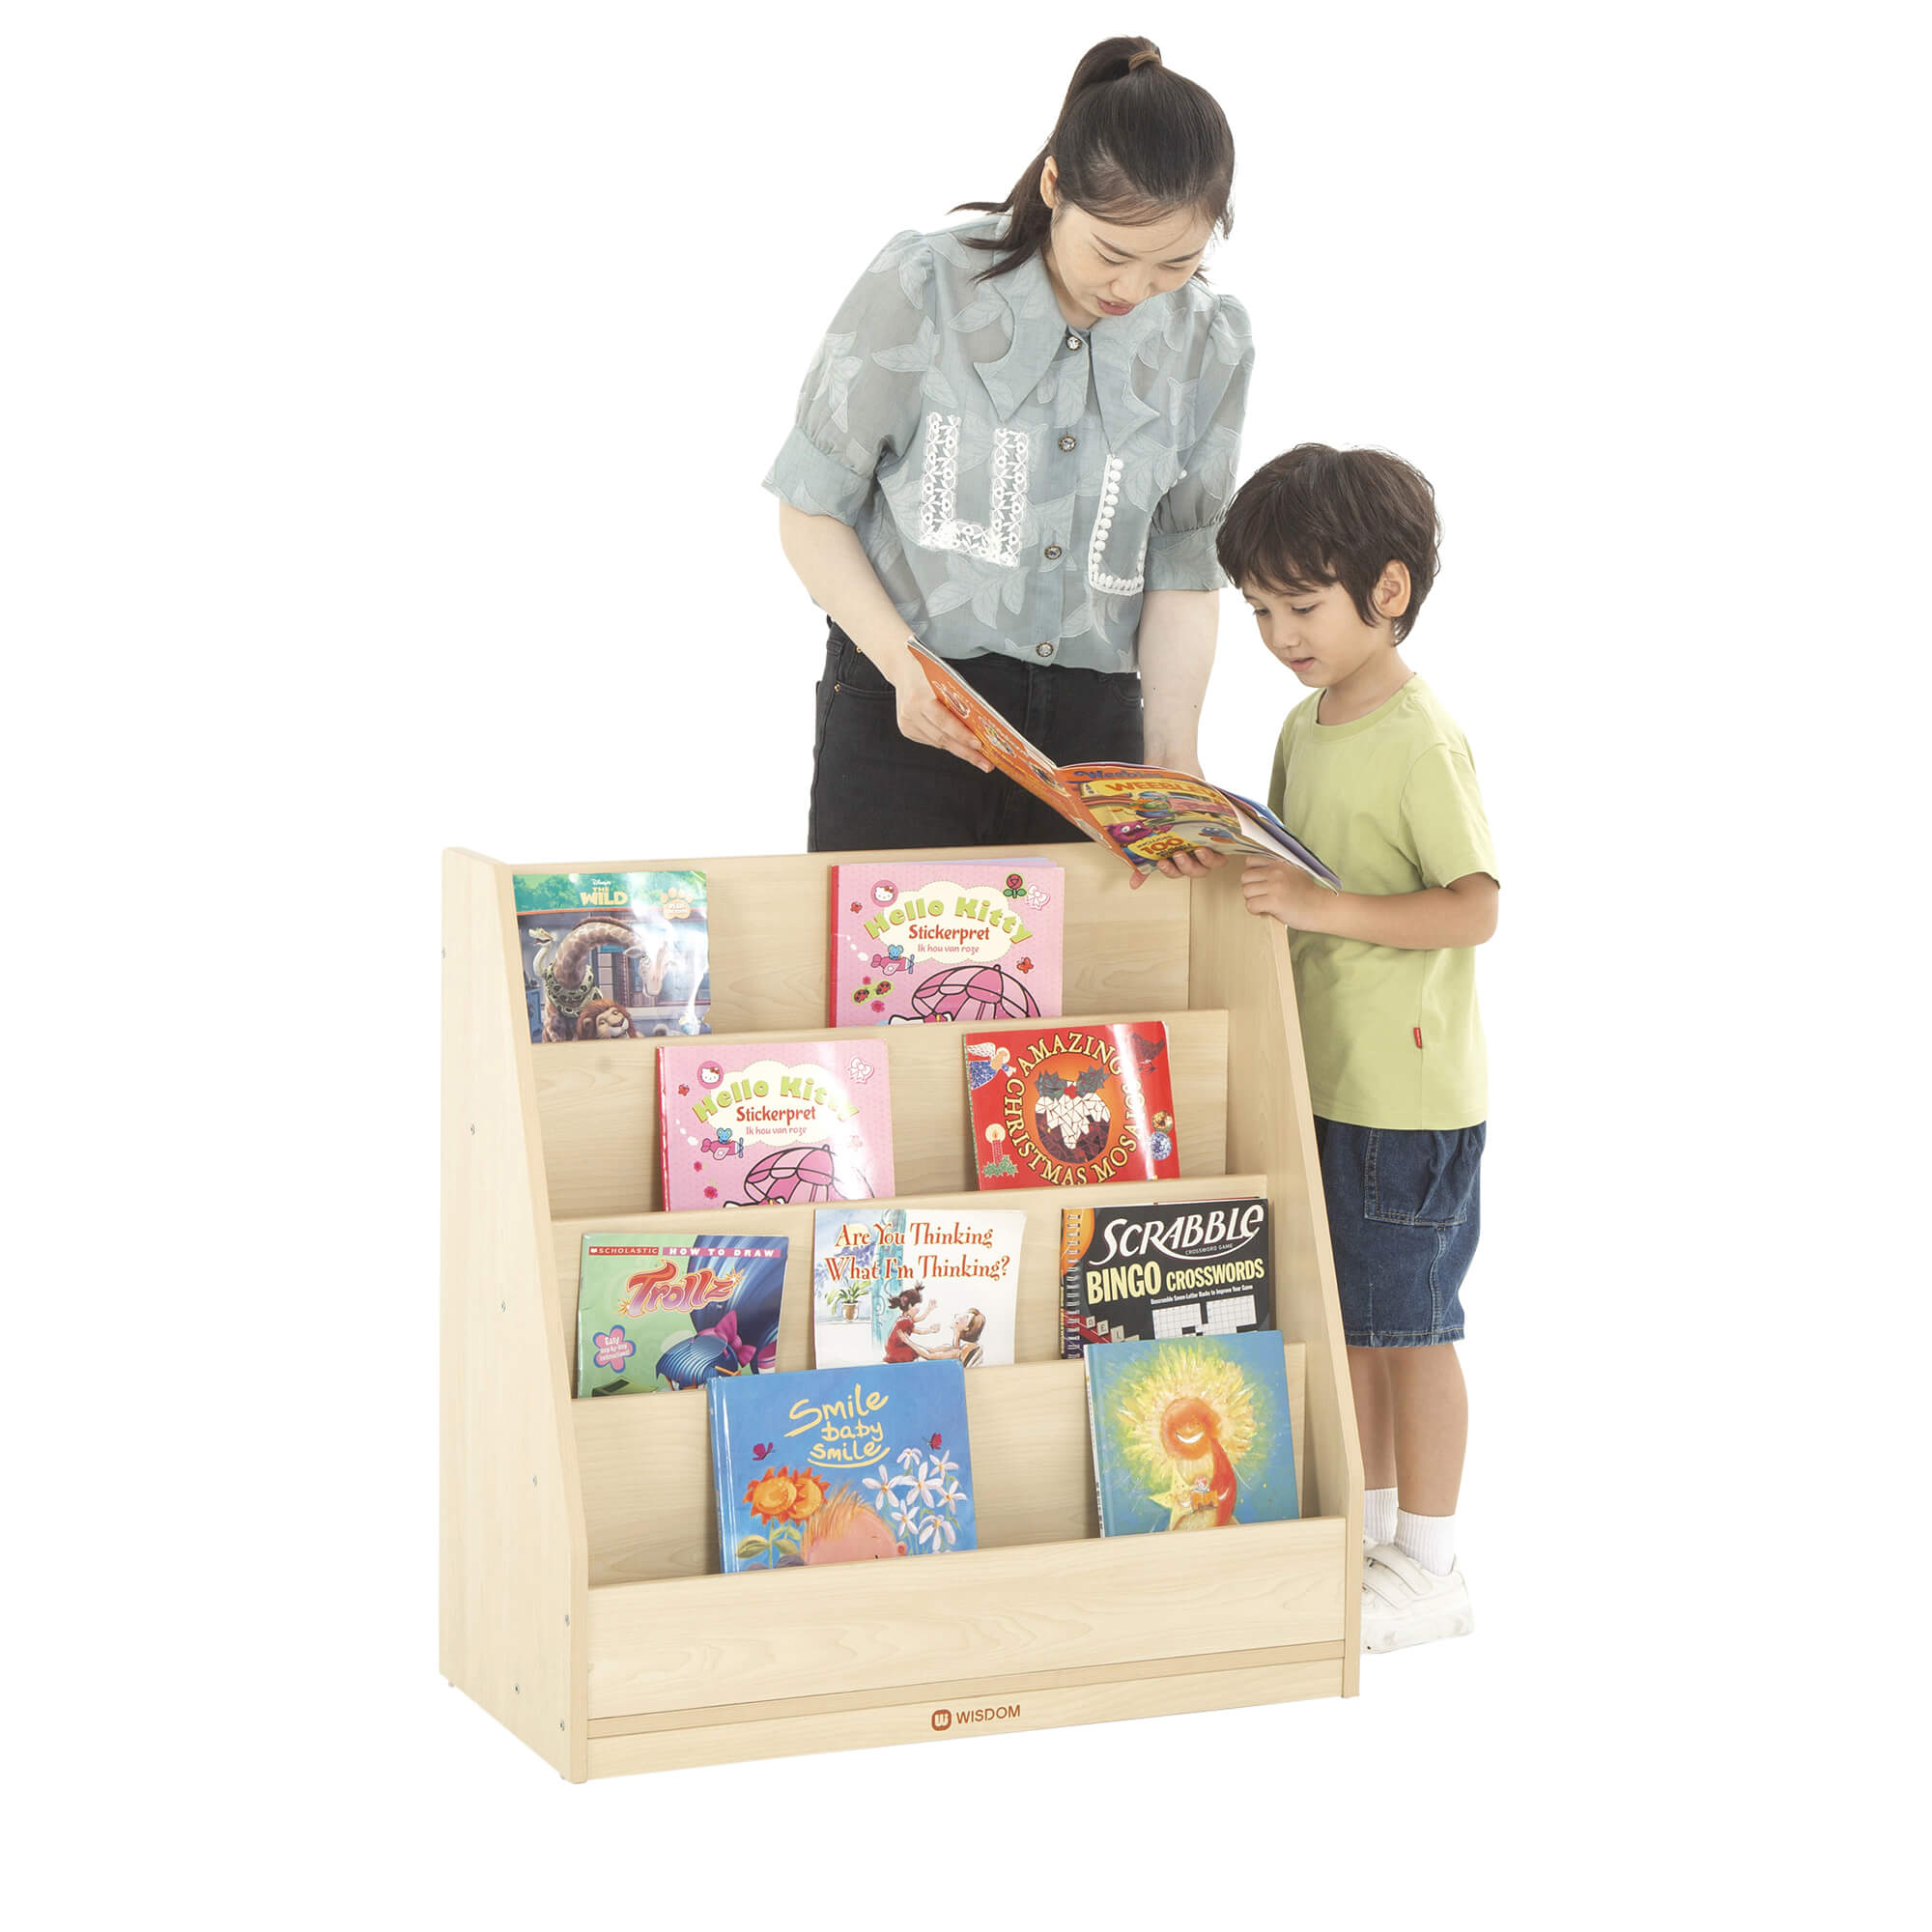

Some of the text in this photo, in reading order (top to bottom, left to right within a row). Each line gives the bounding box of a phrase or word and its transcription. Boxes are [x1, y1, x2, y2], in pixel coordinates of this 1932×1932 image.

[1140, 838, 1184, 855] 100
[581, 891, 628, 905] WILD
[864, 896, 1033, 944] Hello Kitty
[908, 924, 990, 945] Stickerpret
[918, 944, 925, 952] Ik
[927, 944, 943, 952] hou
[961, 945, 980, 955] roze
[1016, 1032, 1124, 1077] AMAZING
[692, 1079, 769, 1123] Hello
[736, 1105, 816, 1125] Stickerpret
[746, 1126, 753, 1135] Ik
[755, 1126, 771, 1135] hou
[788, 1126, 807, 1137] roze
[1004, 1078, 1088, 1187] CHRISTMAS
[835, 1222, 994, 1248] Are You Thinking
[1185, 1245, 1217, 1256] CROSSWORD
[824, 1254, 1010, 1281] What I'm Thinking?
[627, 1259, 735, 1319] Trollz
[1086, 1258, 1265, 1305] BINGO CROSSWORDS
[783, 1383, 889, 1437] Smile
[821, 1419, 884, 1442] baby
[810, 1441, 882, 1462] smile
[955, 1704, 1021, 1724] WISDOM
